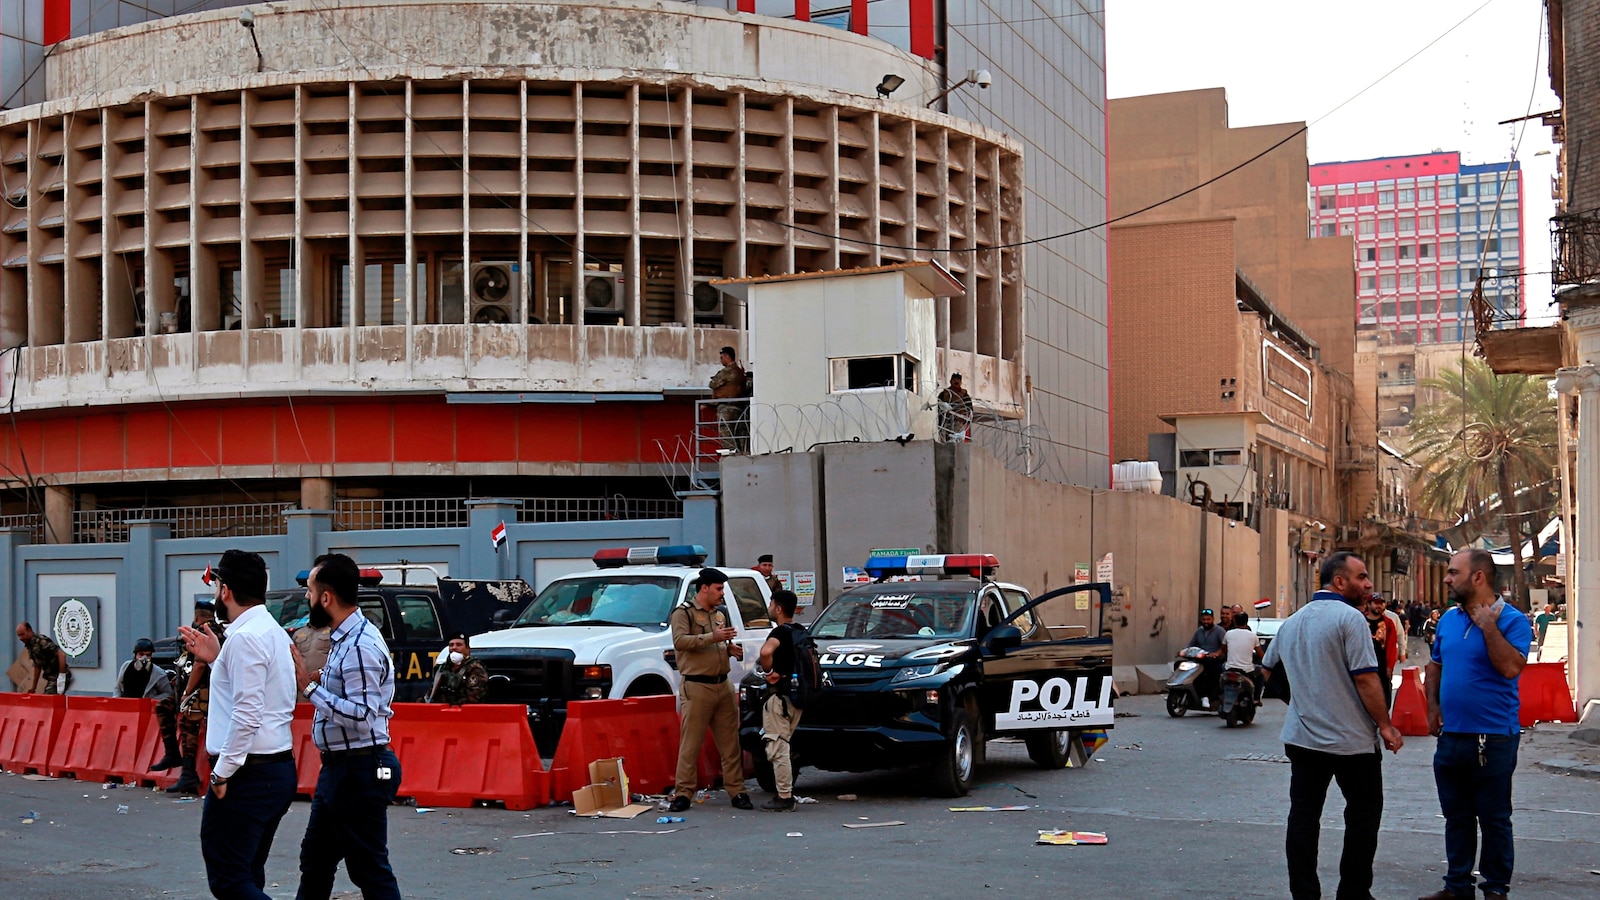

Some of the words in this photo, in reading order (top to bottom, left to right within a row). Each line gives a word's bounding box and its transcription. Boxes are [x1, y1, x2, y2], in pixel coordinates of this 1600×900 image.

[818, 653, 885, 668] LICE
[1008, 675, 1113, 714] POLI
[1069, 709, 1091, 722] قاطع
